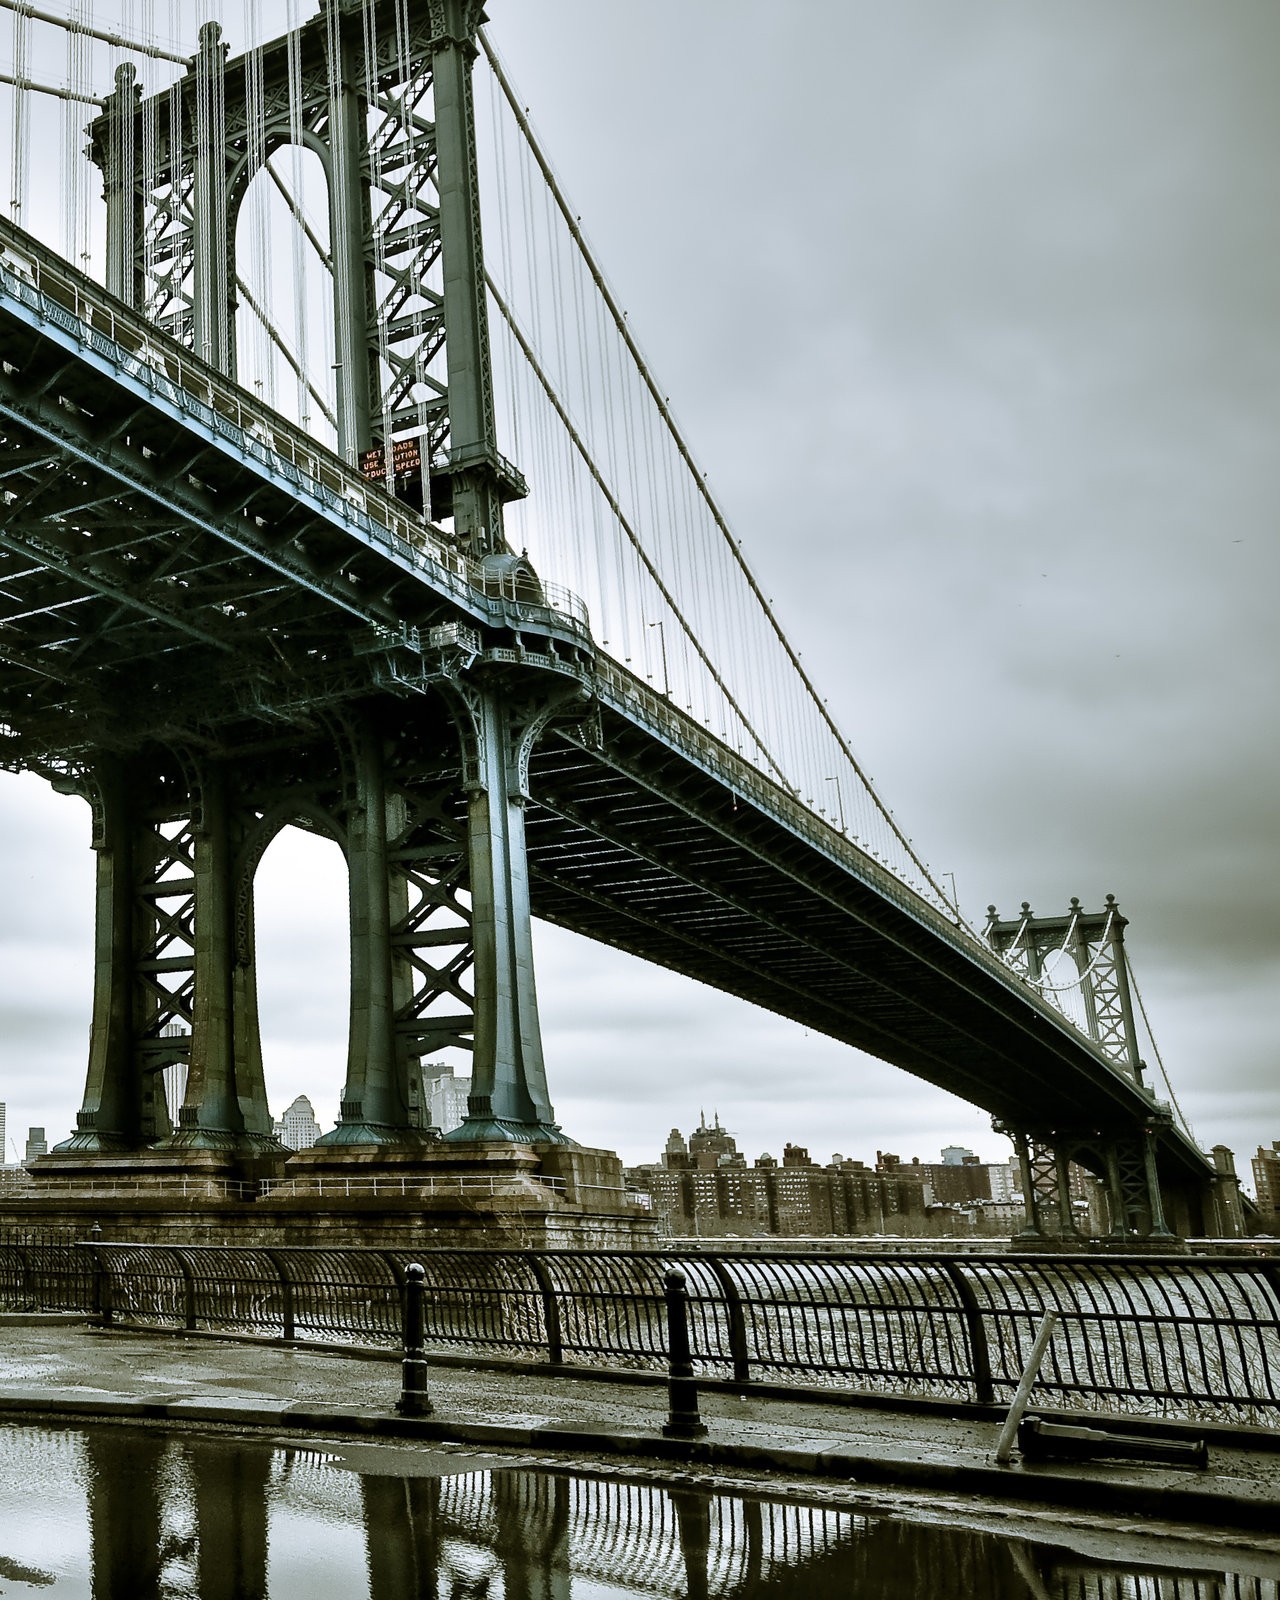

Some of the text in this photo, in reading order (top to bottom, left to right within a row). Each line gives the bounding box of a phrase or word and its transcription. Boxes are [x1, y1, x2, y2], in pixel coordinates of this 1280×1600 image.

[366, 449, 382, 460] WET
[363, 460, 379, 470] USE
[395, 458, 420, 471] SPEED
